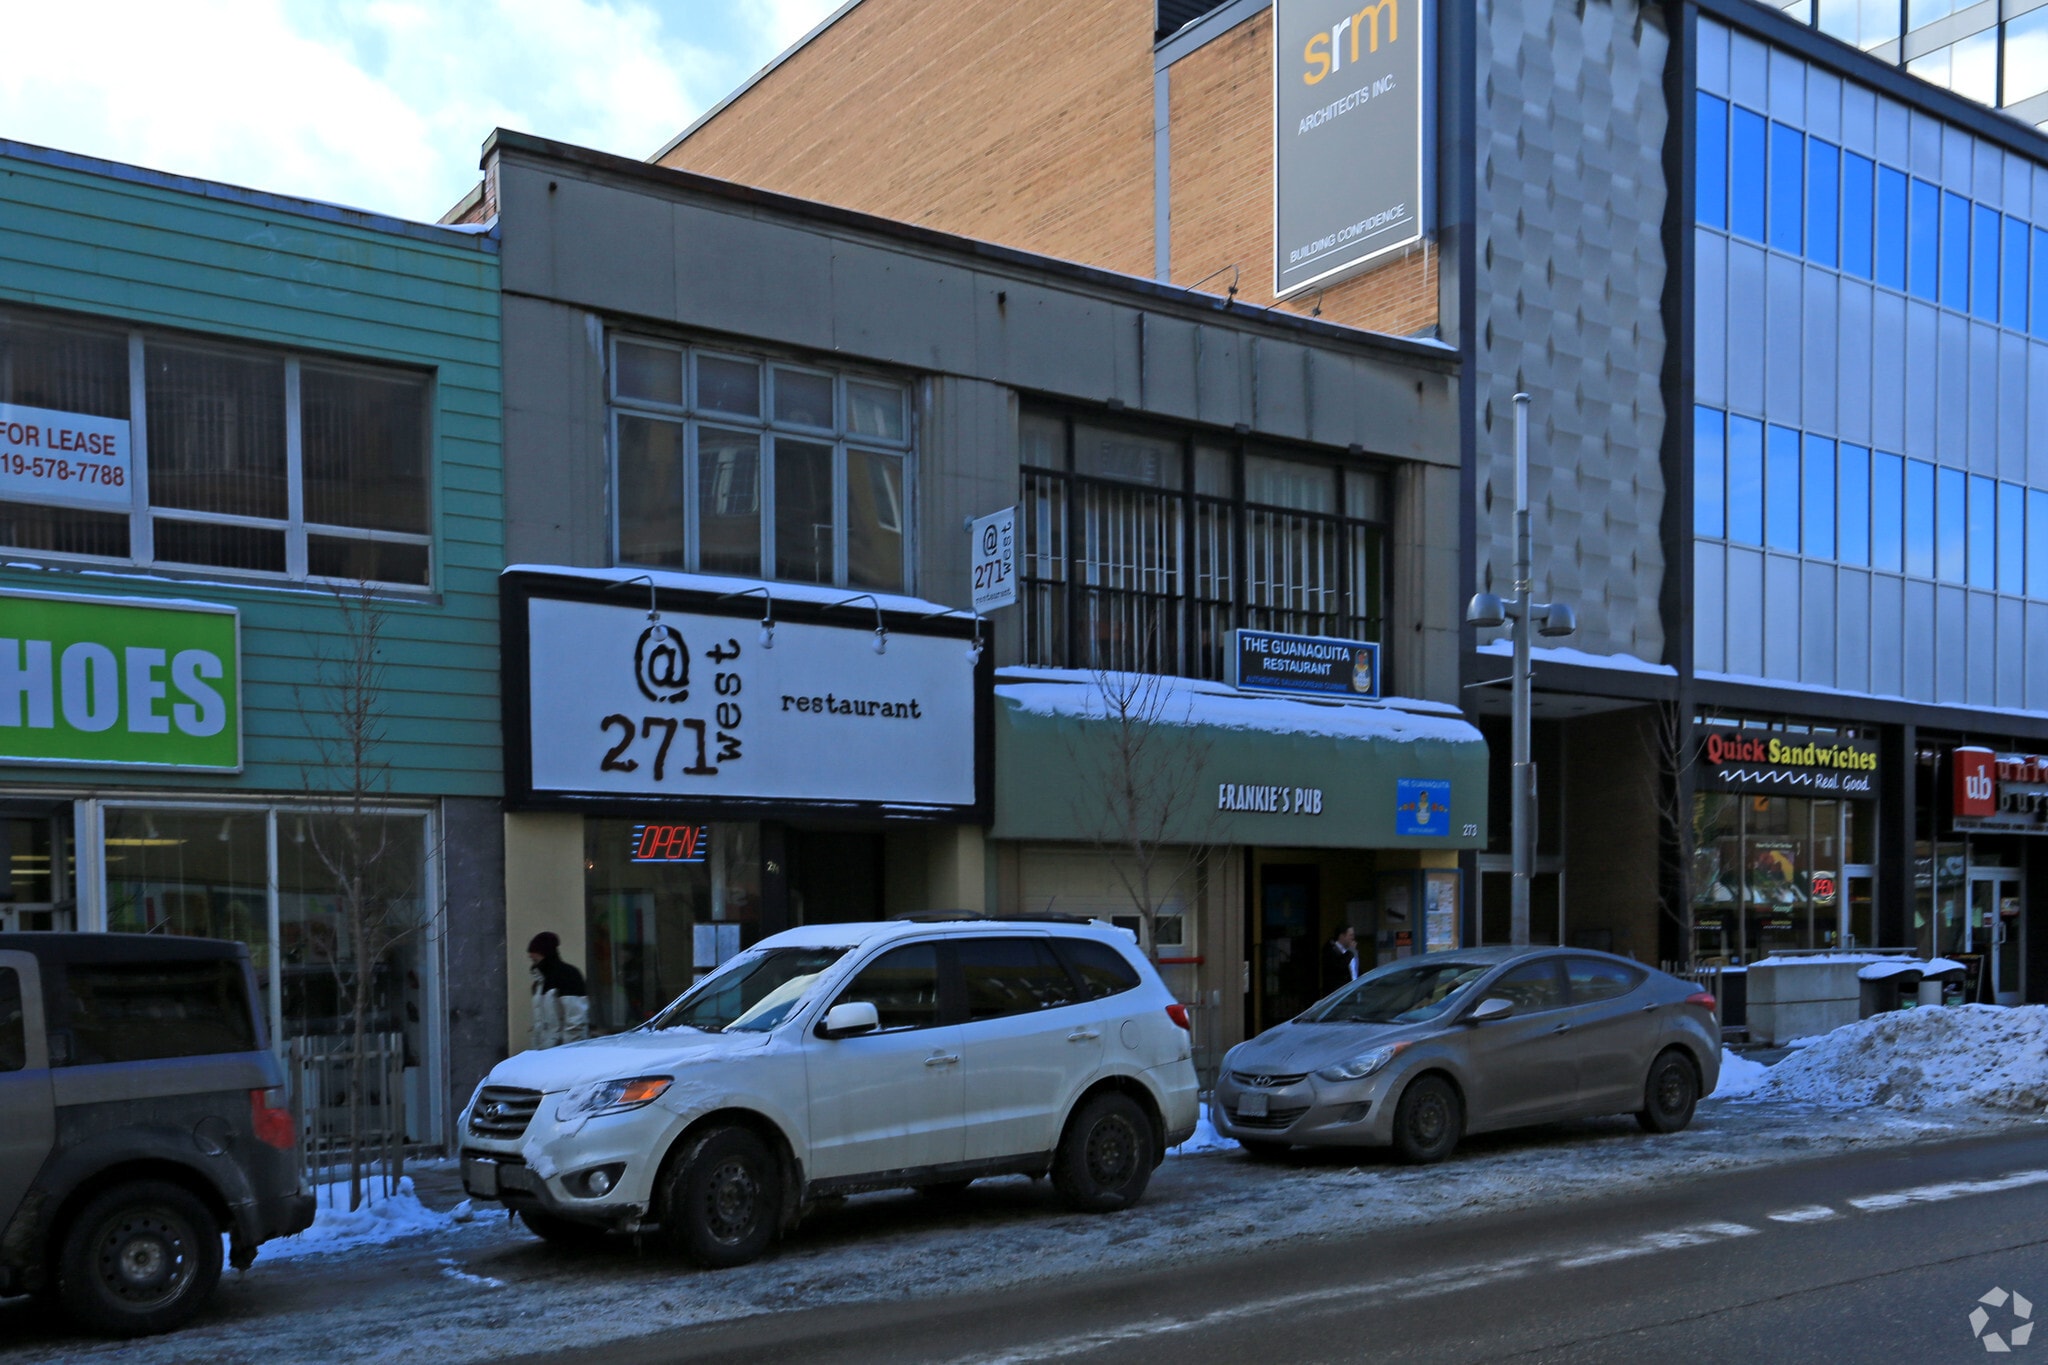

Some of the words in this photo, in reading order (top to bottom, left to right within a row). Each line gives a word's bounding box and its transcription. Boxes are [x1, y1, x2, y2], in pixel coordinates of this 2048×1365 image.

[1303, 0, 1398, 86] srm
[1298, 86, 1370, 136] ARCHITECTS
[1372, 73, 1397, 98] INC.
[1289, 233, 1336, 263] BUILDING
[1337, 203, 1405, 243] CONFIDENCE
[47, 428, 116, 456] LEASE
[0, 453, 125, 487] 19-578-7788
[983, 524, 998, 558] @
[1001, 521, 1012, 575] west
[974, 559, 1005, 590] 271
[634, 624, 690, 703] @
[1243, 636, 1269, 653] THE
[1271, 640, 1351, 662] GUANAQUITA
[1263, 657, 1333, 676] RESTAURANT
[0, 637, 227, 738] HOES
[705, 638, 743, 764] west
[781, 692, 922, 719] restaurant
[600, 713, 719, 782] 271
[1707, 733, 1767, 765] Quick
[1768, 737, 1878, 771] Sandwiches
[1815, 773, 1840, 790] Real
[1965, 764, 1993, 801] ub
[1996, 756, 2048, 783] uni
[1218, 783, 1291, 812] FRANKIE'S
[1294, 787, 1323, 815] PUB
[1999, 783, 2048, 815] bur
[637, 825, 700, 859] OPEN
[1462, 824, 1478, 837] 273
